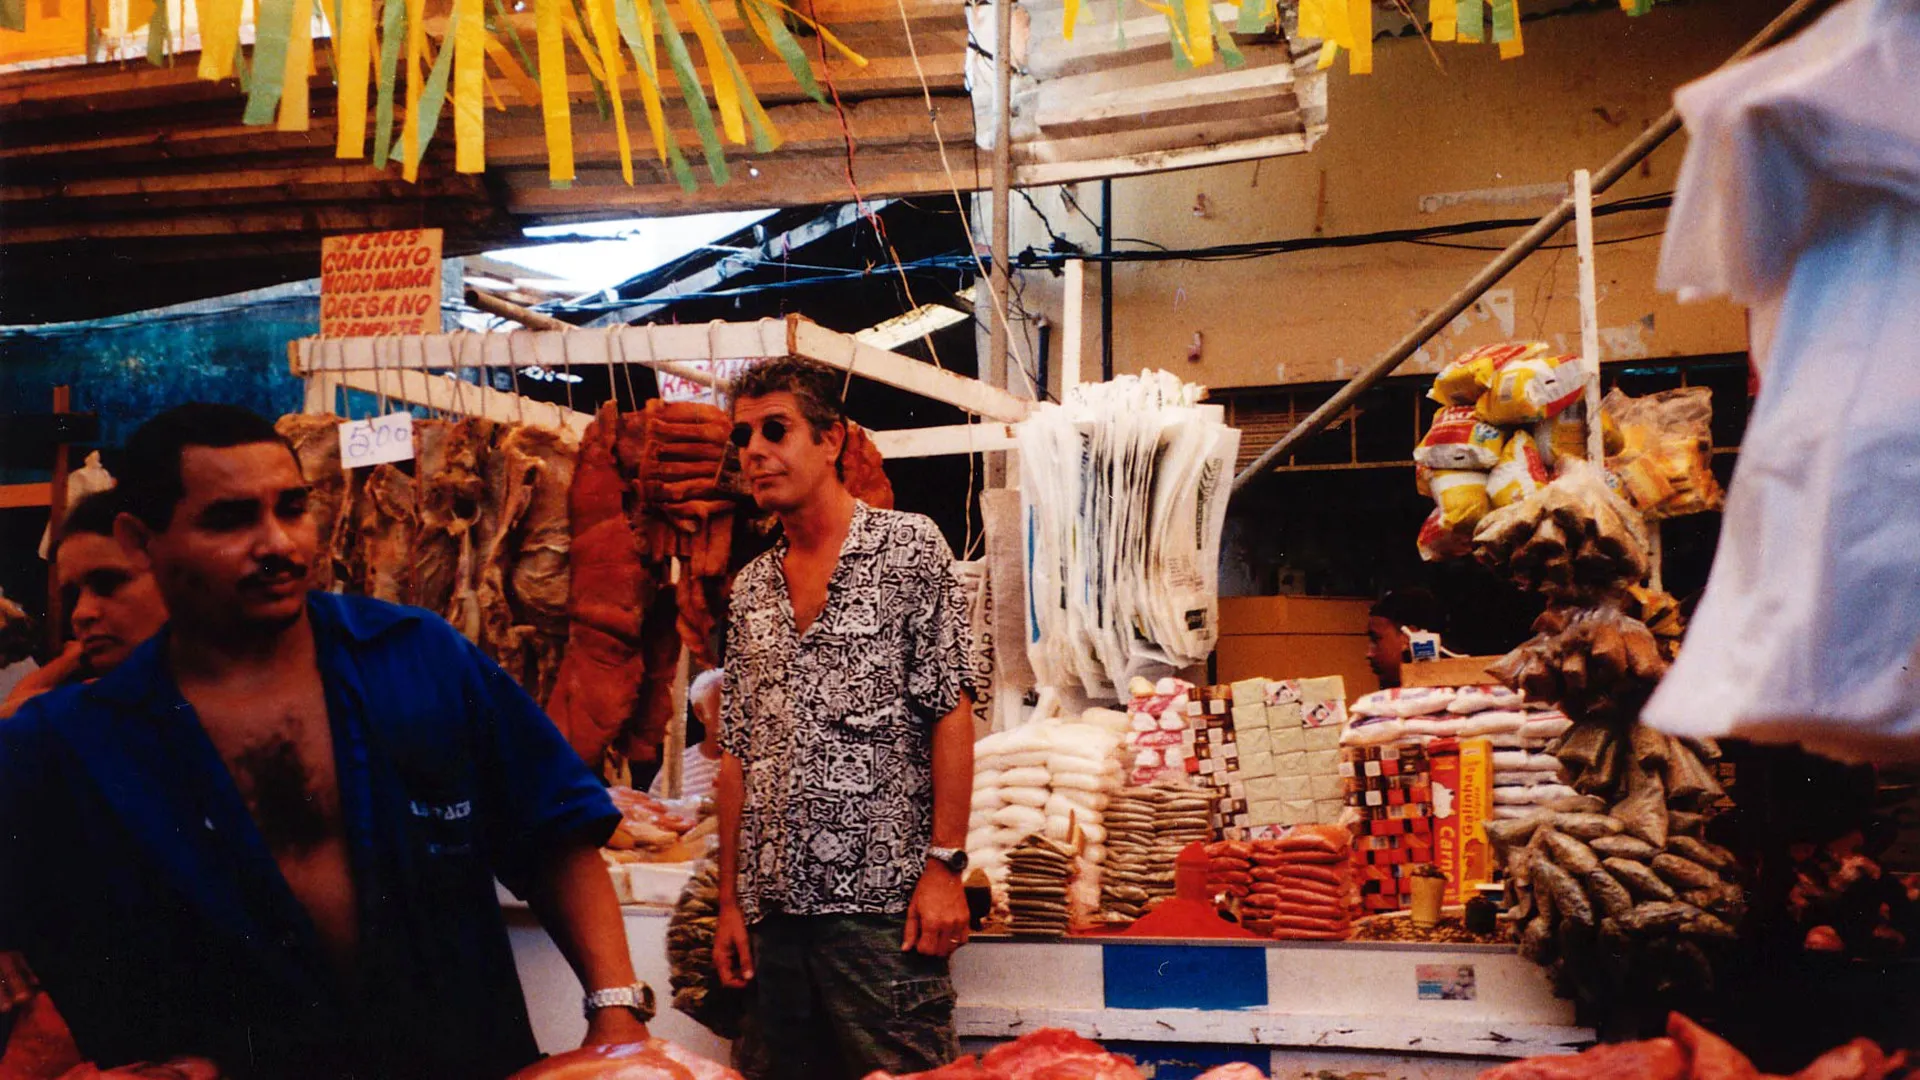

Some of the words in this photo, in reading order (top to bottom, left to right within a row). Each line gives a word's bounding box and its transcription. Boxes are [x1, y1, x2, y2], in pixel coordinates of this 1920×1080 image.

[344, 231, 420, 250] TEMOS
[322, 246, 431, 274] COMINHO
[321, 272, 373, 295] MOIDO
[323, 294, 432, 320] OREGANO
[1462, 775, 1474, 836] Galinha
